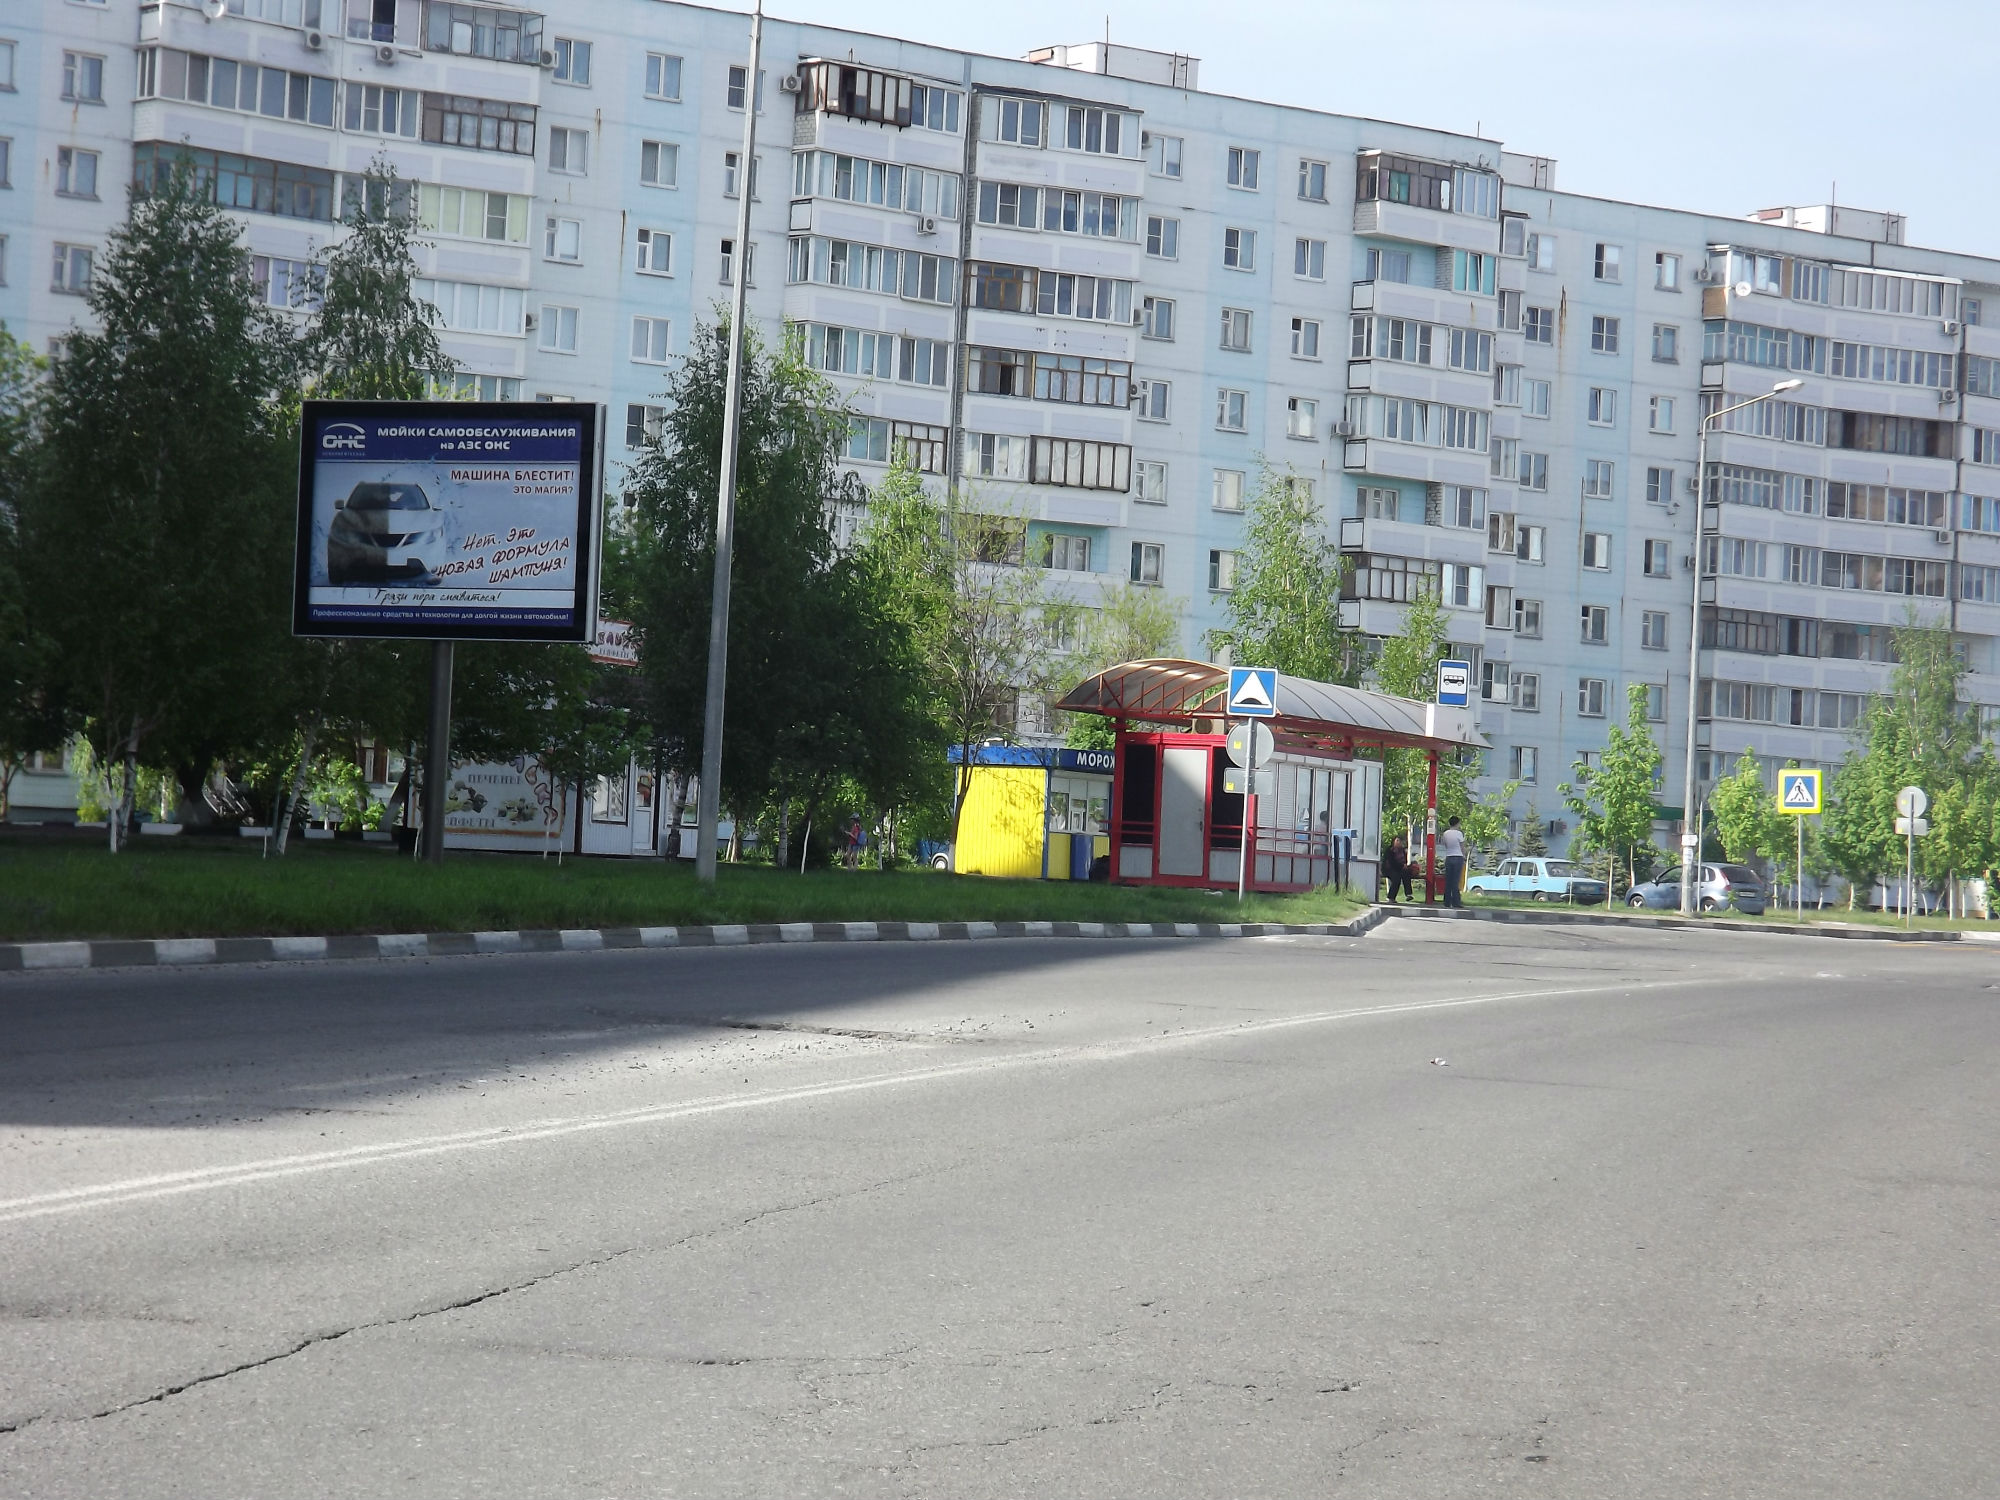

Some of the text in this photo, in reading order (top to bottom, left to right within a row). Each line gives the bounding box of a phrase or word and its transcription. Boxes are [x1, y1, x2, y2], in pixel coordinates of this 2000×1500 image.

[377, 425, 577, 438] МОЙКИ САМООБСЛУЖИВАНИЯ
[440, 441, 511, 450] на АЗС ОНС
[451, 470, 575, 481] МАШИНА БЛЕСТИТ!
[513, 485, 574, 494] ЭТО МАГИЯ?
[462, 527, 536, 551] Нет. Это
[437, 537, 570, 577] НОВАЯ ФОРМУЛА
[488, 556, 568, 584] ШАМПУНЯ!
[313, 609, 381, 618] Профессиональные
[382, 611, 414, 619] средства
[474, 611, 498, 620] долгой
[523, 612, 569, 621] автомобиля!
